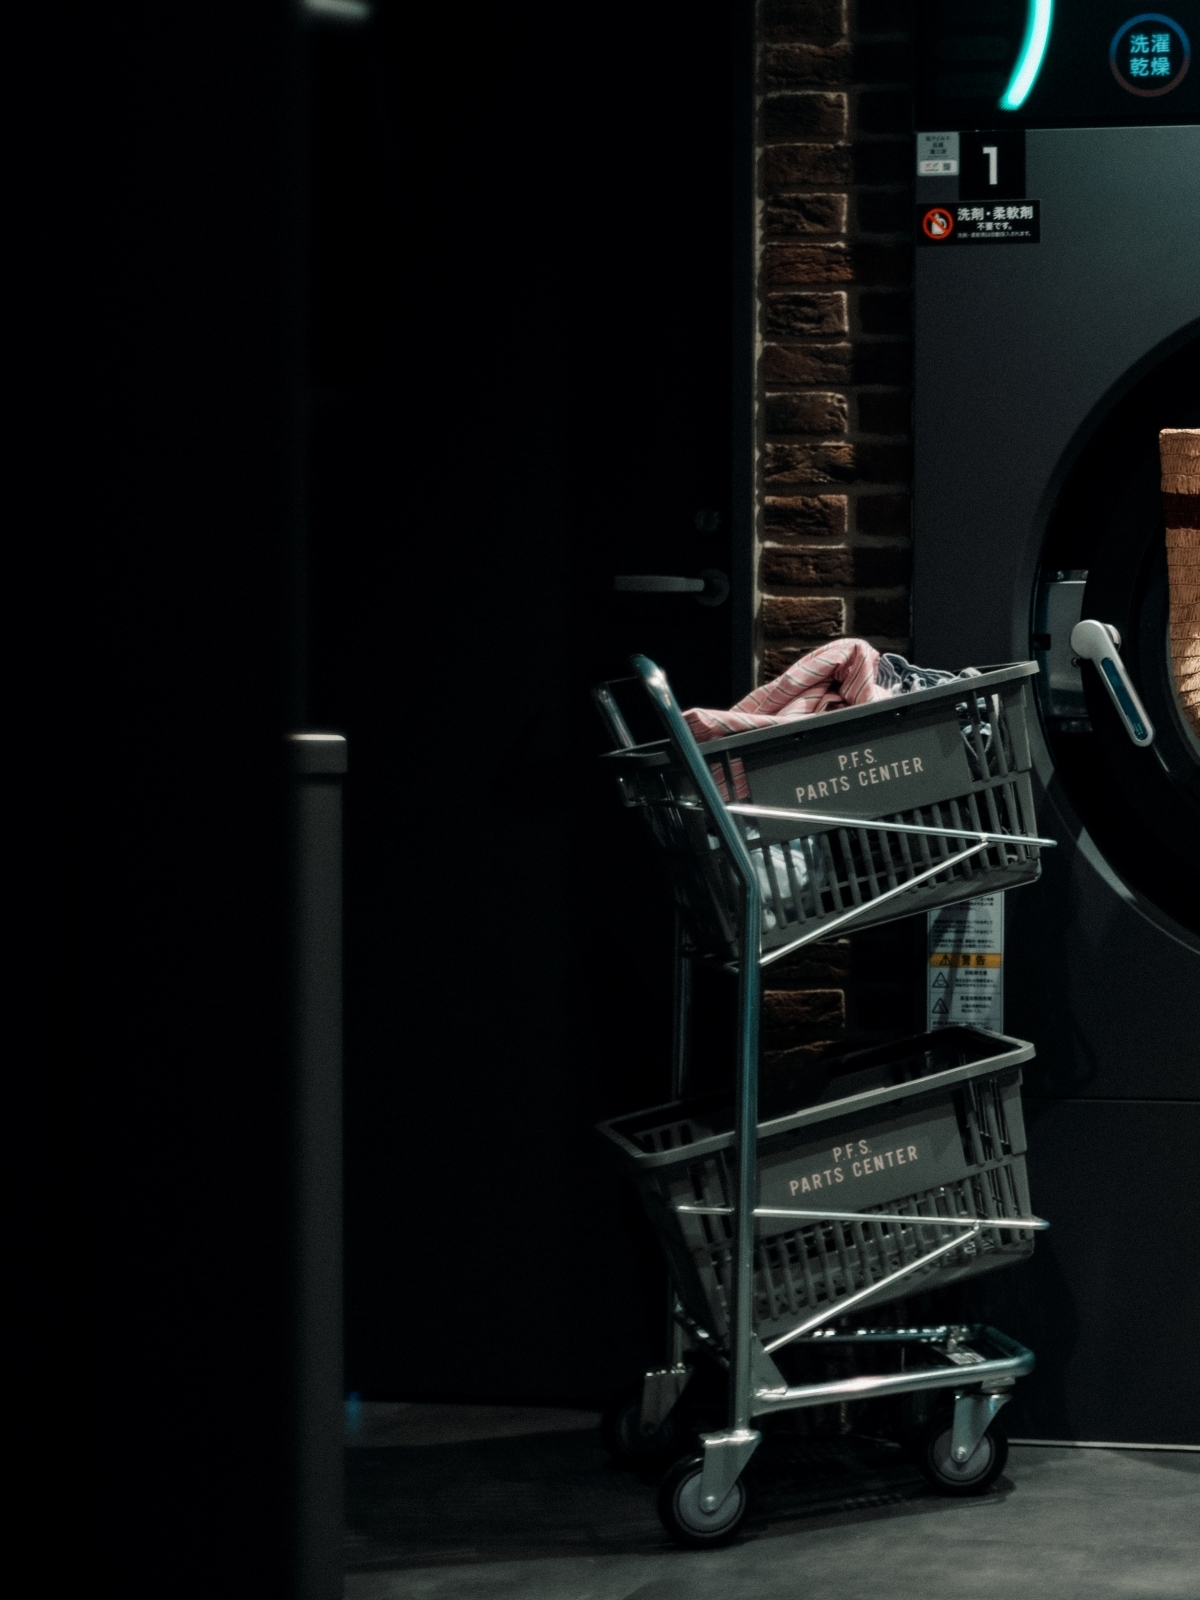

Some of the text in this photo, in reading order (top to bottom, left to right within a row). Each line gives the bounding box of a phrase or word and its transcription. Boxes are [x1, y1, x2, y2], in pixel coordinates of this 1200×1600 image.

[1129, 33, 1170, 53] 洗濯
[1129, 57, 1170, 77] 乾燥
[982, 146, 998, 185] 1
[957, 206, 1034, 221] 洗剤・柔軟剤
[976, 221, 1013, 231] 不要です。
[795, 757, 924, 803] PARTS CENTER
[789, 1145, 918, 1196] PARTS CENTER
